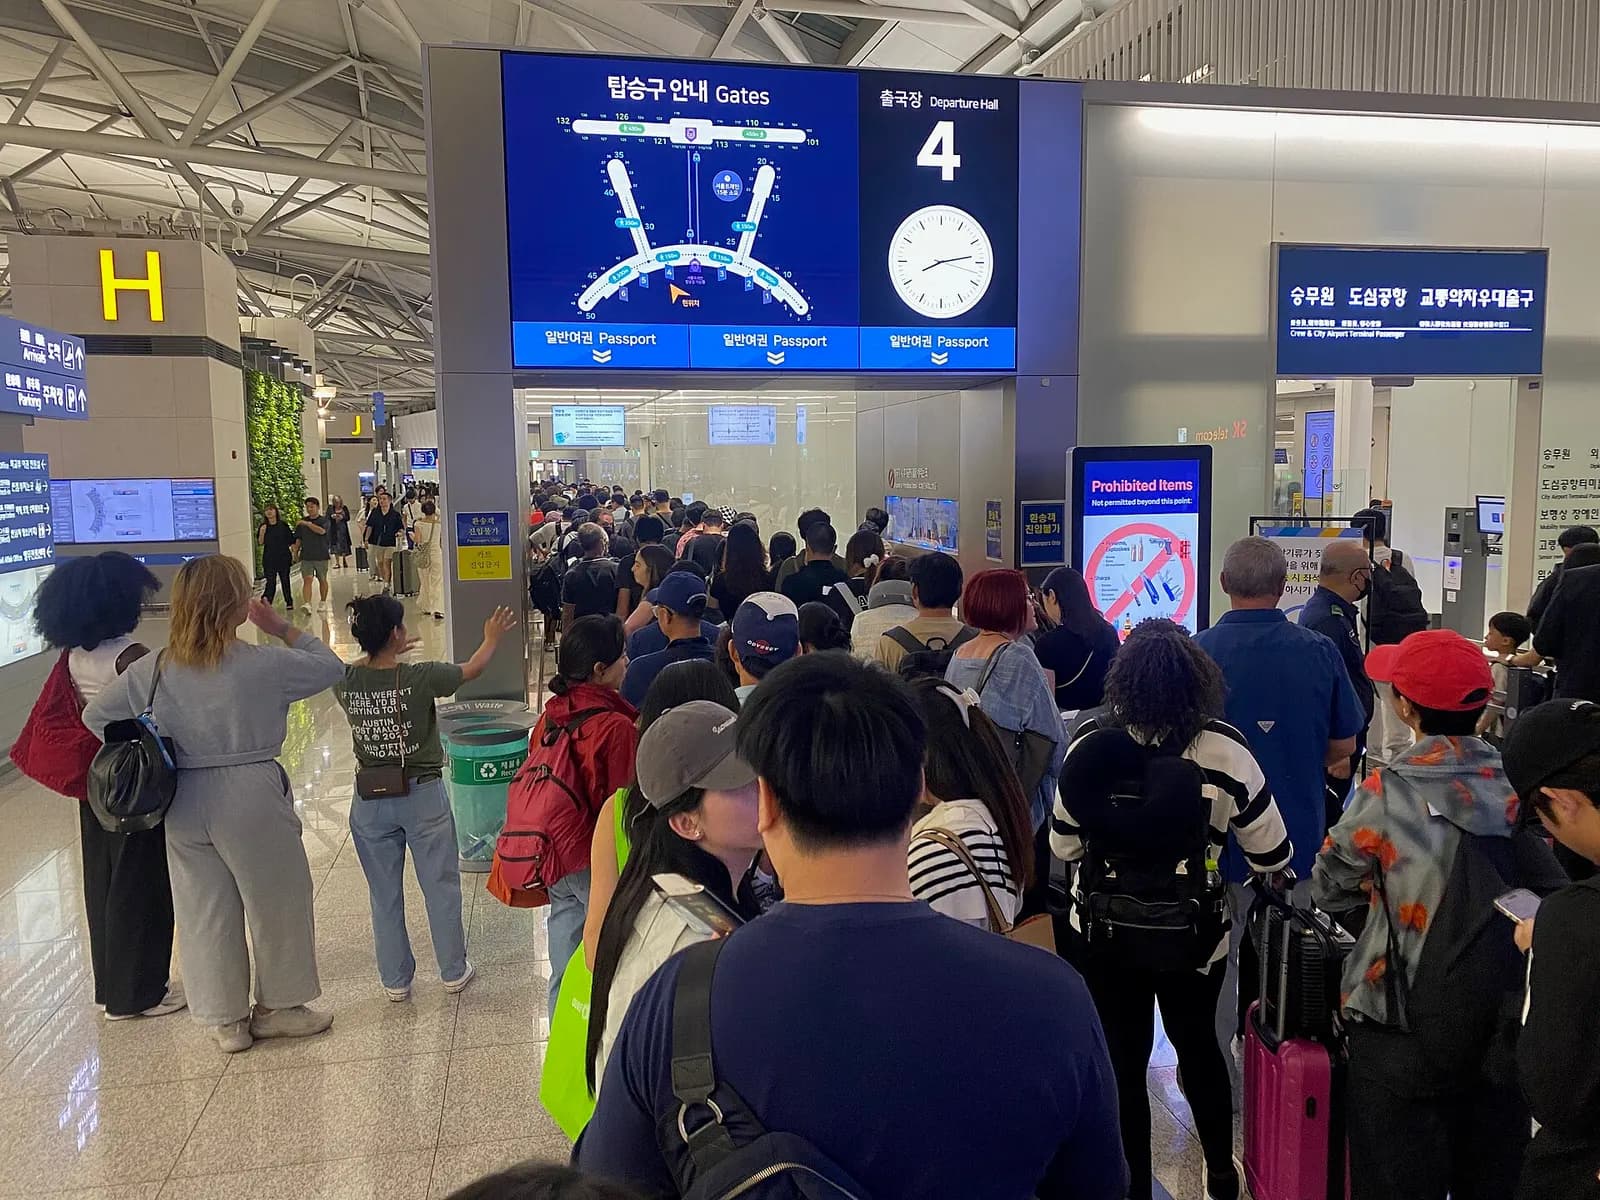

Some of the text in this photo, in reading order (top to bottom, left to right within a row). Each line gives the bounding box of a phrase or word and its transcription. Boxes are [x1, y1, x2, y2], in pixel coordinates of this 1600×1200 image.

[607, 75, 770, 106] 탑승구 안내 Gates
[880, 89, 999, 111] 출국장 Departure Hall
[555, 117, 570, 125] 132
[615, 113, 629, 121] 126
[745, 119, 759, 127] 110
[614, 151, 624, 159] 35
[916, 120, 961, 181] 4
[757, 157, 767, 165] 20
[603, 189, 614, 197] 40
[771, 194, 780, 202] 15
[726, 238, 736, 246] 25
[587, 272, 598, 280] 45
[642, 276, 648, 284] 5
[99, 248, 165, 323] H
[1290, 286, 1534, 308] 승무원 도심공항 교통약자우대출구
[783, 303, 788, 311] 1
[585, 312, 596, 320] 50
[544, 330, 657, 347] 일반여권 Passport
[1290, 329, 1306, 338] Crew
[1306, 330, 1313, 338] &
[1326, 330, 1348, 340] Airport
[1349, 330, 1374, 338] Terminal
[1375, 330, 1406, 340] Passenger
[722, 333, 828, 348] 일반여권 Passport
[890, 334, 989, 350] 일반여권 Passport
[23, 346, 47, 365] Arrivals
[47, 342, 61, 363] 도착
[42, 384, 64, 407] 주차장
[17, 391, 42, 412] Parking
[351, 415, 361, 436] J
[1543, 448, 1571, 460] 승무원
[1091, 479, 1193, 493] Prohibited Items
[1091, 499, 1104, 507] Not
[1104, 499, 1136, 508] permitted
[1136, 498, 1161, 507] beyond
[1173, 498, 1193, 506] point:
[1540, 509, 1599, 521] 보행상 장애인
[1025, 523, 1060, 535] 진입불가
[341, 691, 349, 700] IF
[349, 691, 370, 700] Y'ALL
[350, 699, 374, 708] HERE,
[375, 698, 388, 707] I'D
[348, 707, 380, 715] CRYING
[362, 717, 394, 728] AUSTIN
